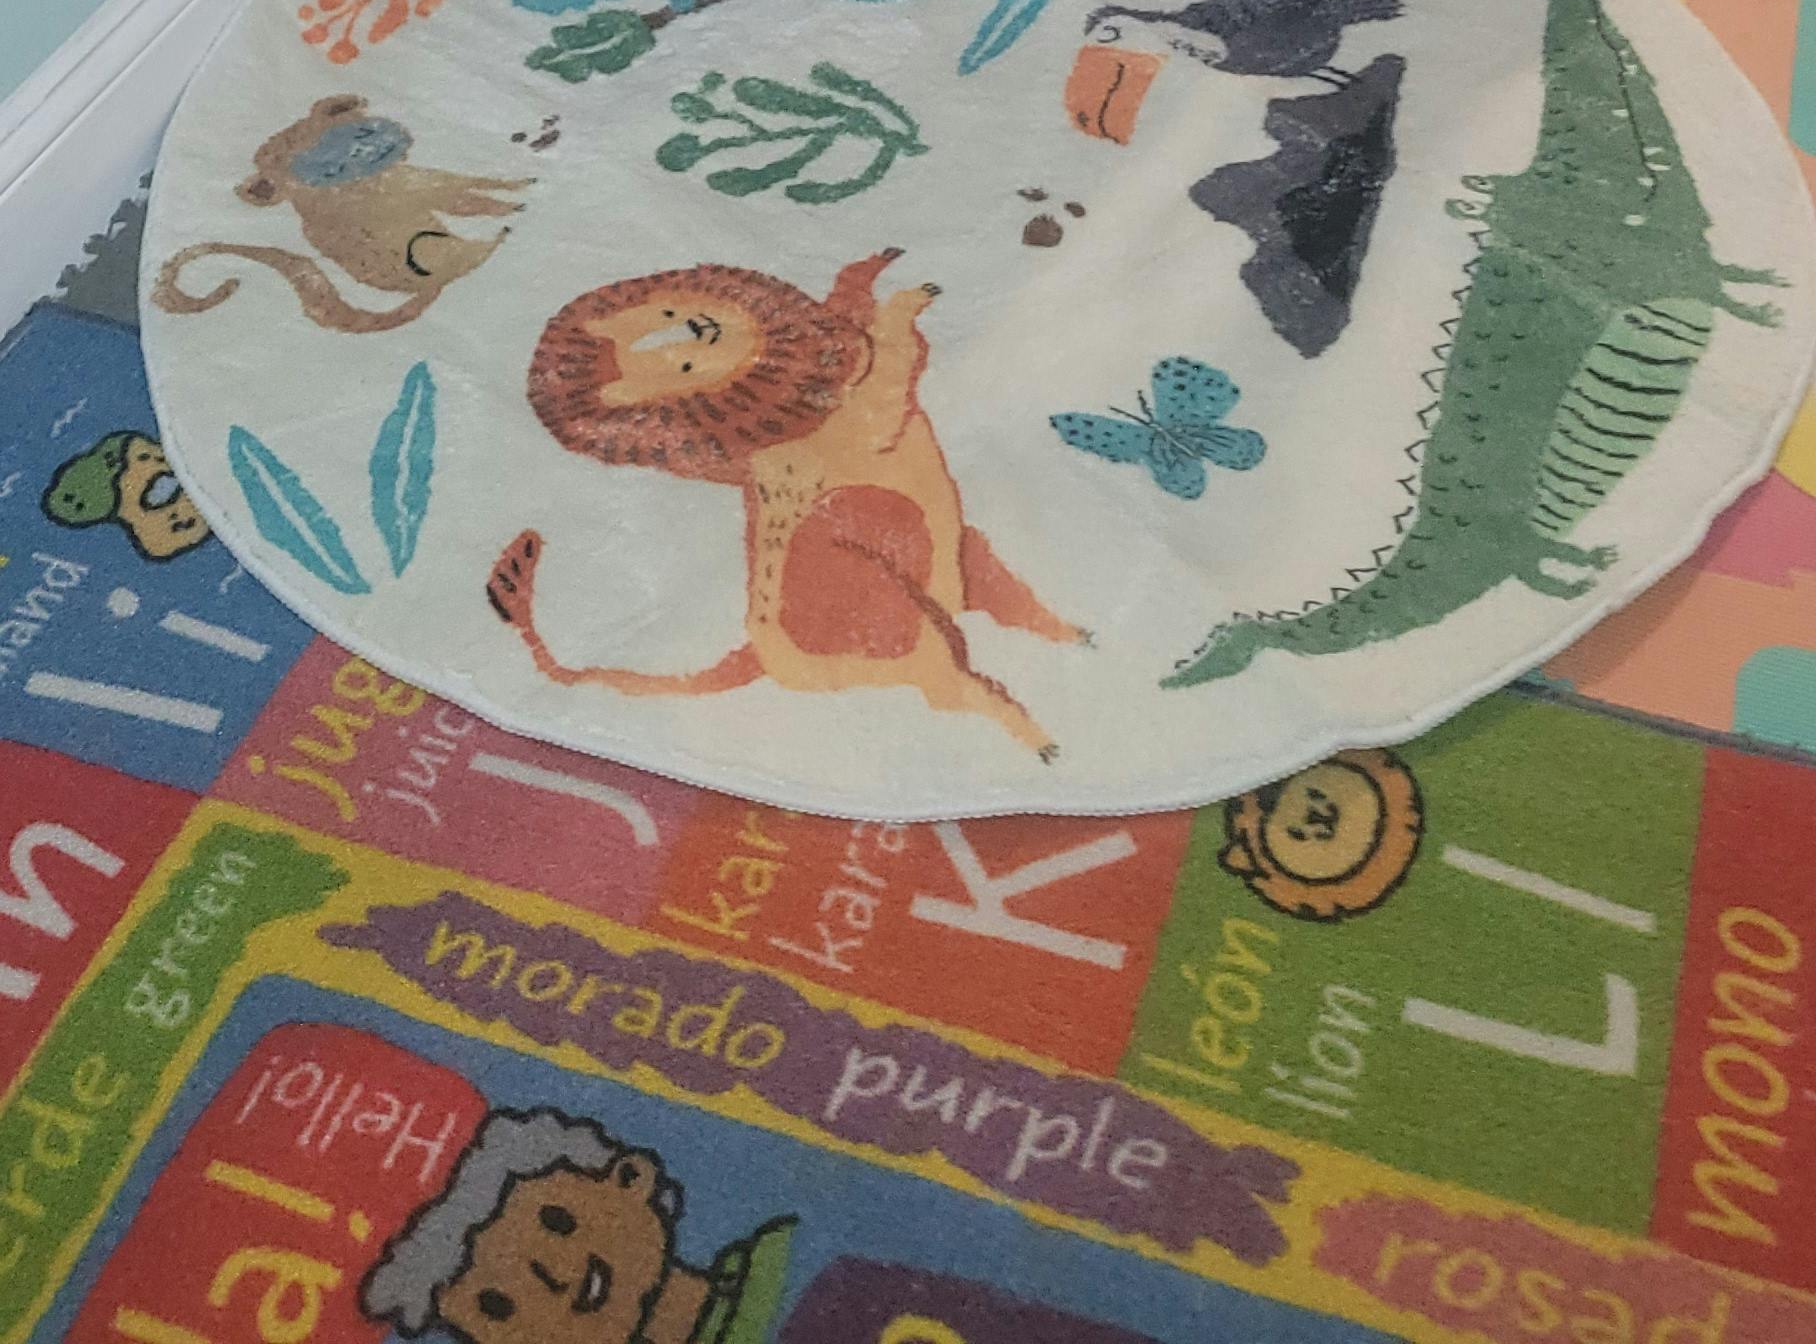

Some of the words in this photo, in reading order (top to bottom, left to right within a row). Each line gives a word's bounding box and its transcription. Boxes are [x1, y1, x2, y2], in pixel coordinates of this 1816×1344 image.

[247, 657, 430, 822] jug
[363, 703, 478, 826] juic
[125, 850, 258, 1029] green
[660, 810, 791, 942] kar
[425, 920, 786, 1070] morado
[1140, 915, 1281, 1096] león
[1264, 983, 1377, 1120] lion
[237, 1054, 459, 1184] Hello!
[824, 1044, 1169, 1191] purple
[1686, 905, 1803, 1249] mono
